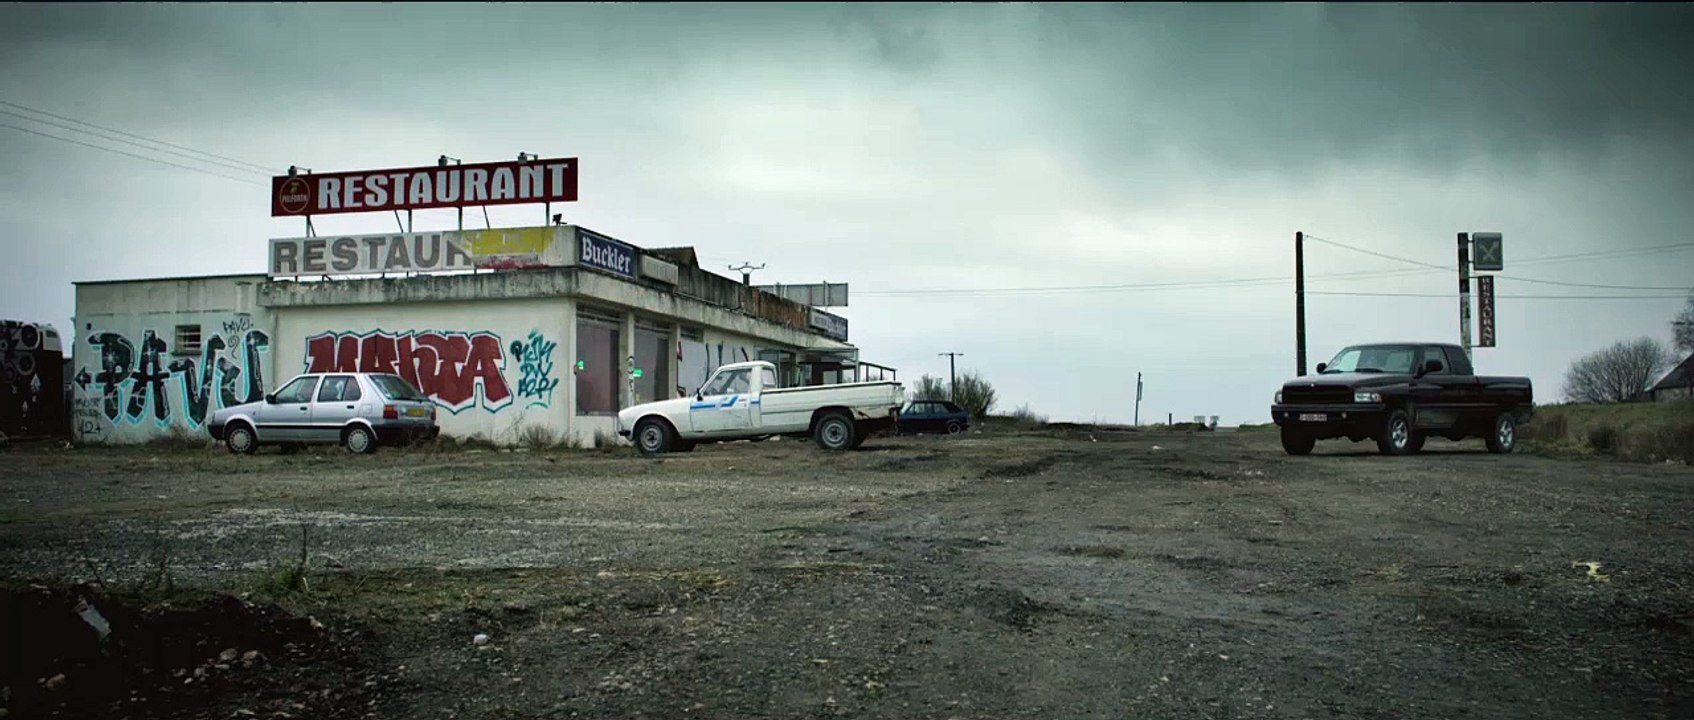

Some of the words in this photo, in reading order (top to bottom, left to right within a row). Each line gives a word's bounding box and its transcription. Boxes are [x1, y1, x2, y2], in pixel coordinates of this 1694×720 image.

[318, 163, 568, 209] RESTAURANT
[582, 236, 632, 274] Buckler
[1482, 277, 1493, 346] RESTAURANT
